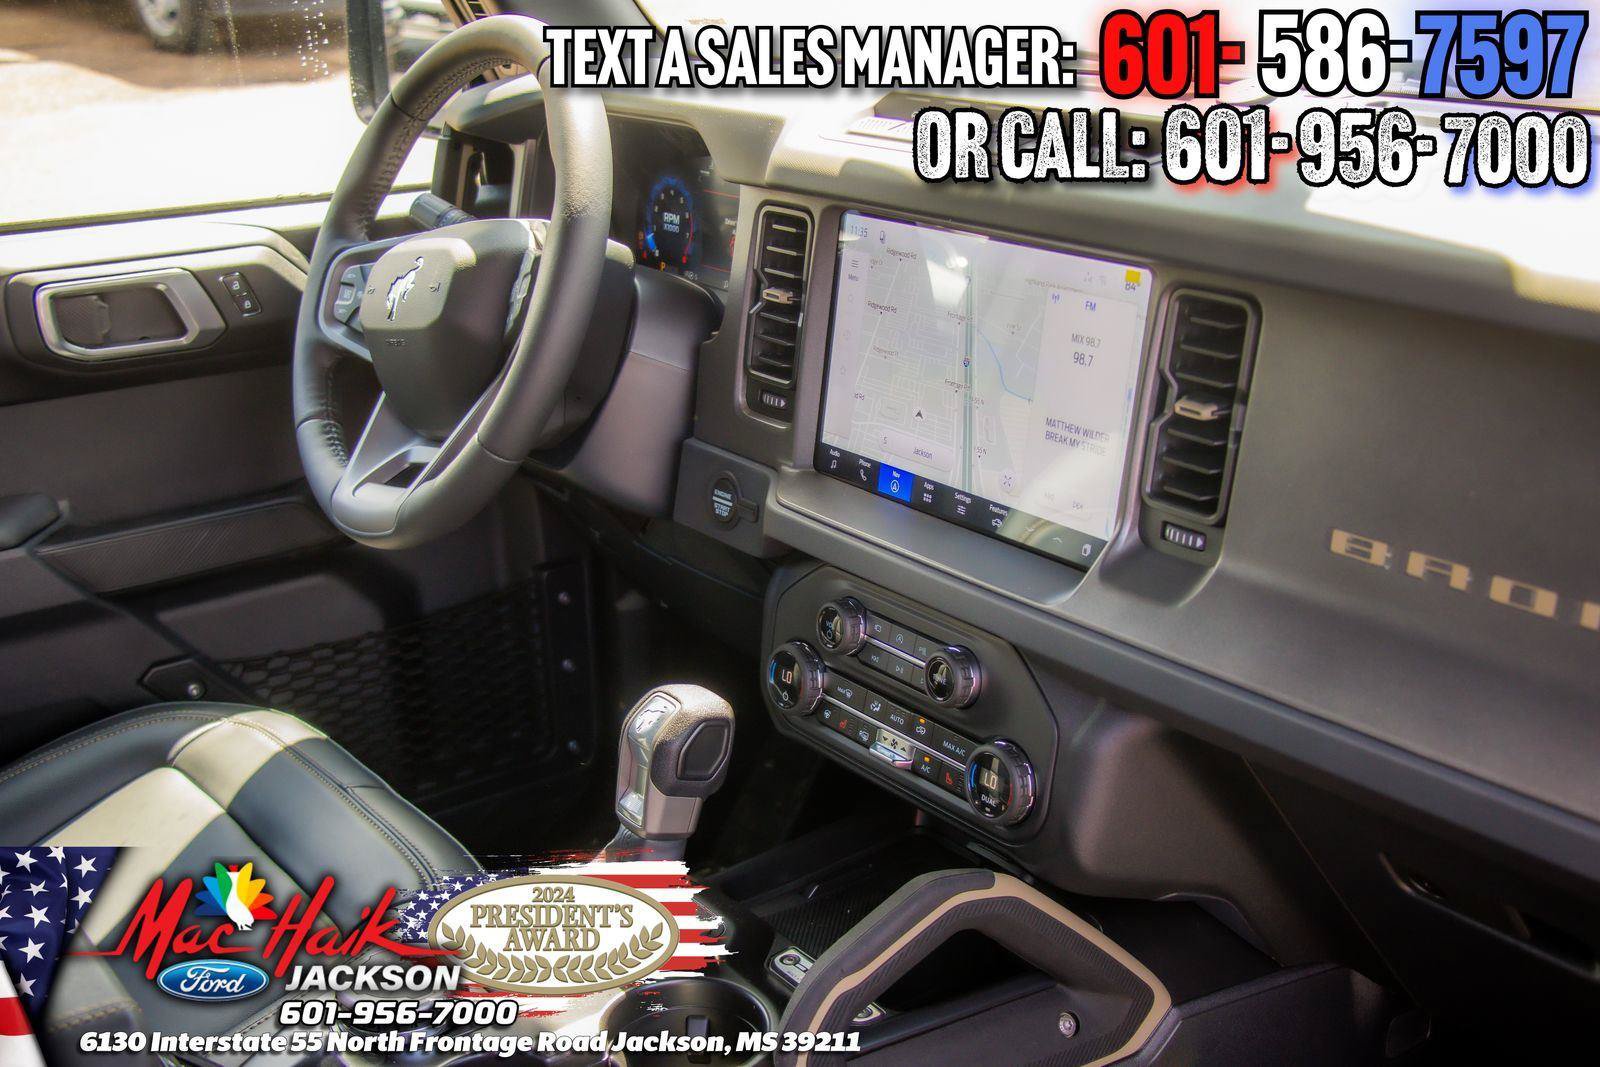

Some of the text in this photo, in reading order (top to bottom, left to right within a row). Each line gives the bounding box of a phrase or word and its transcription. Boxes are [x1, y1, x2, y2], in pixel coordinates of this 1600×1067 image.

[663, 212, 680, 224] RPM
[1084, 300, 1097, 312] FM
[1071, 333, 1101, 350] MIX 98.7
[1073, 351, 1094, 368] 98.7
[1045, 416, 1110, 443] MATTHEW WILDER
[1045, 430, 1068, 446] BREAK
[1068, 438, 1081, 448] MY
[913, 447, 933, 461] Jackson
[858, 458, 872, 469] Phone
[923, 481, 935, 492] Apps
[954, 491, 972, 504] Settings
[989, 504, 1008, 517] Features
[889, 713, 905, 725] AUTO
[943, 740, 966, 757] MAX A/C
[920, 763, 931, 774] A/C
[980, 793, 998, 807] DUAL
